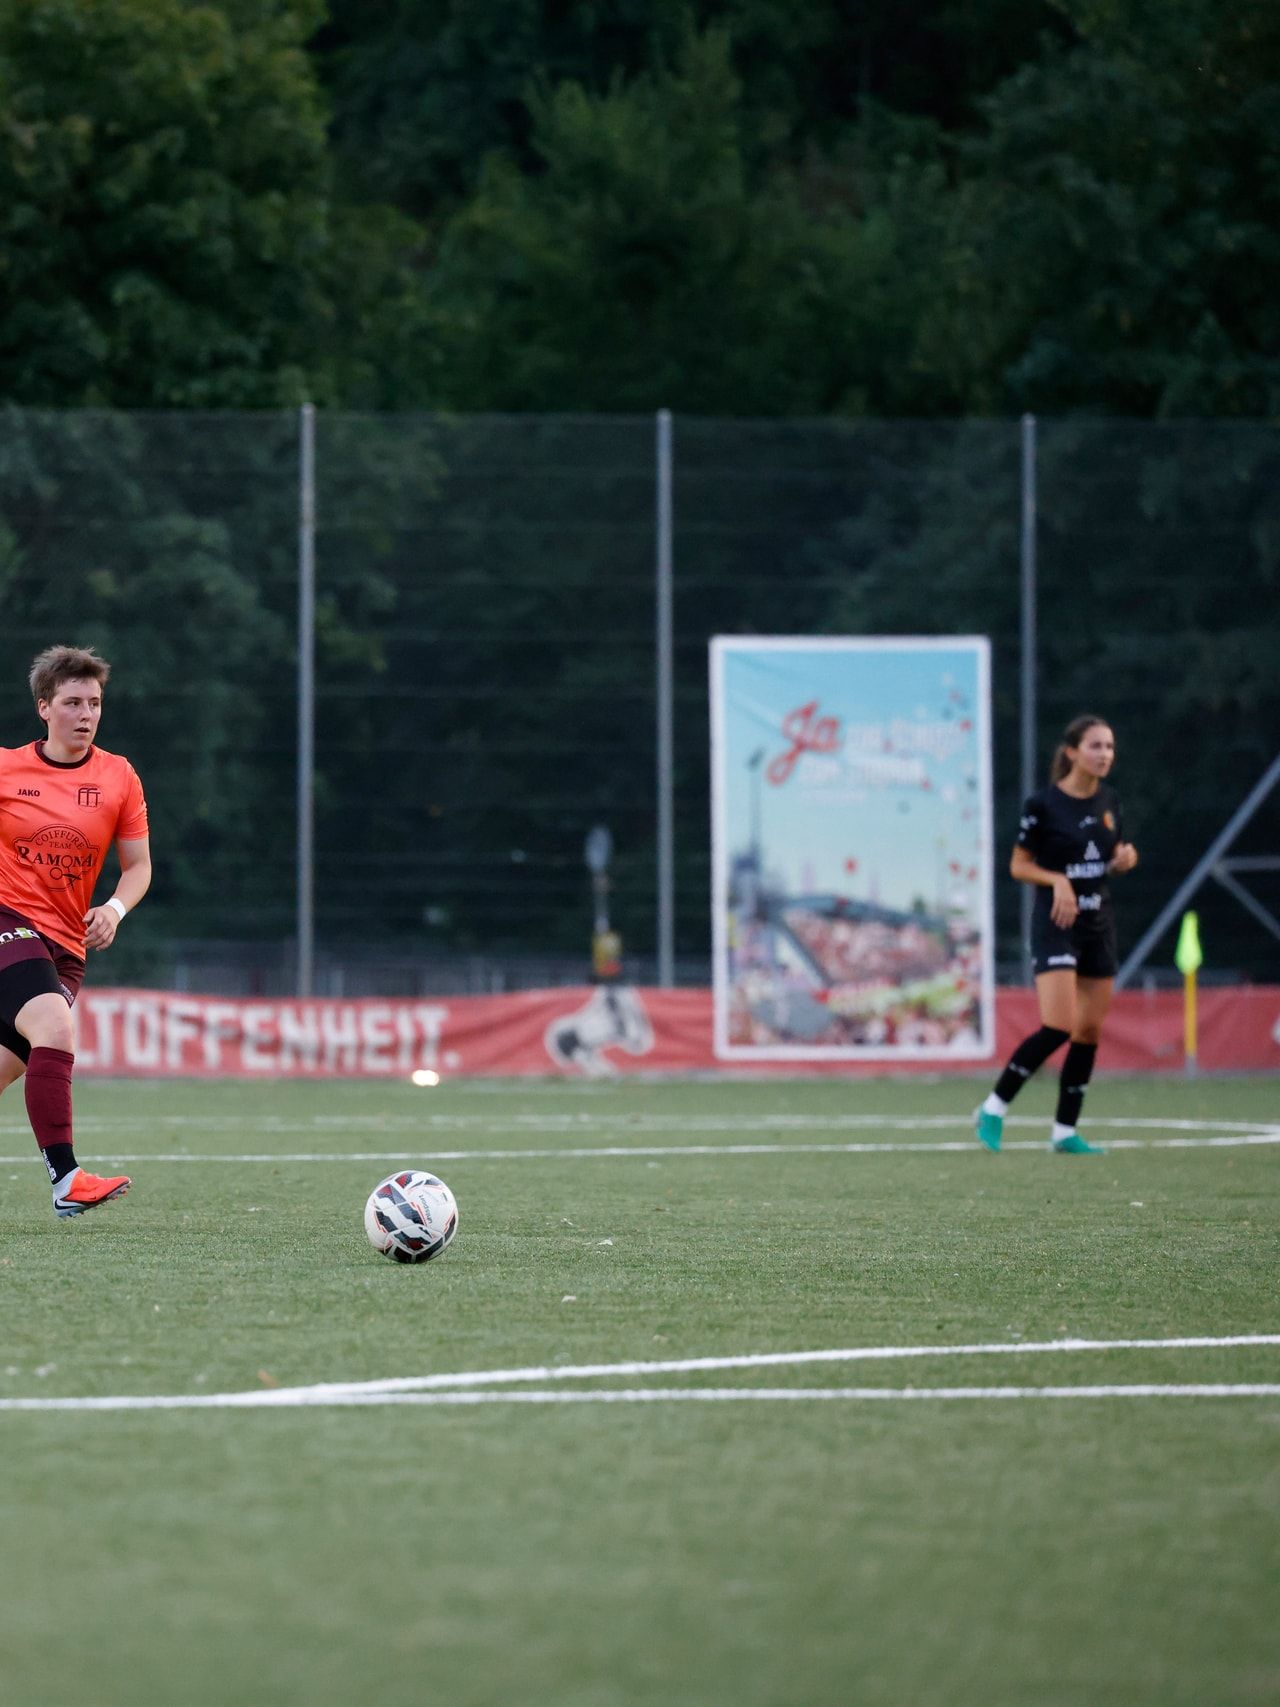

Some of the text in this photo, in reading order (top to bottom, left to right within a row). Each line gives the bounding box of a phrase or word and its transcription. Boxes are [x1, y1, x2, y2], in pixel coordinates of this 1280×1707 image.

[17, 788, 40, 797] JAKO
[35, 829, 86, 849] COIFFURE
[49, 841, 72, 849] TEAM
[17, 845, 93, 868] RAMONA
